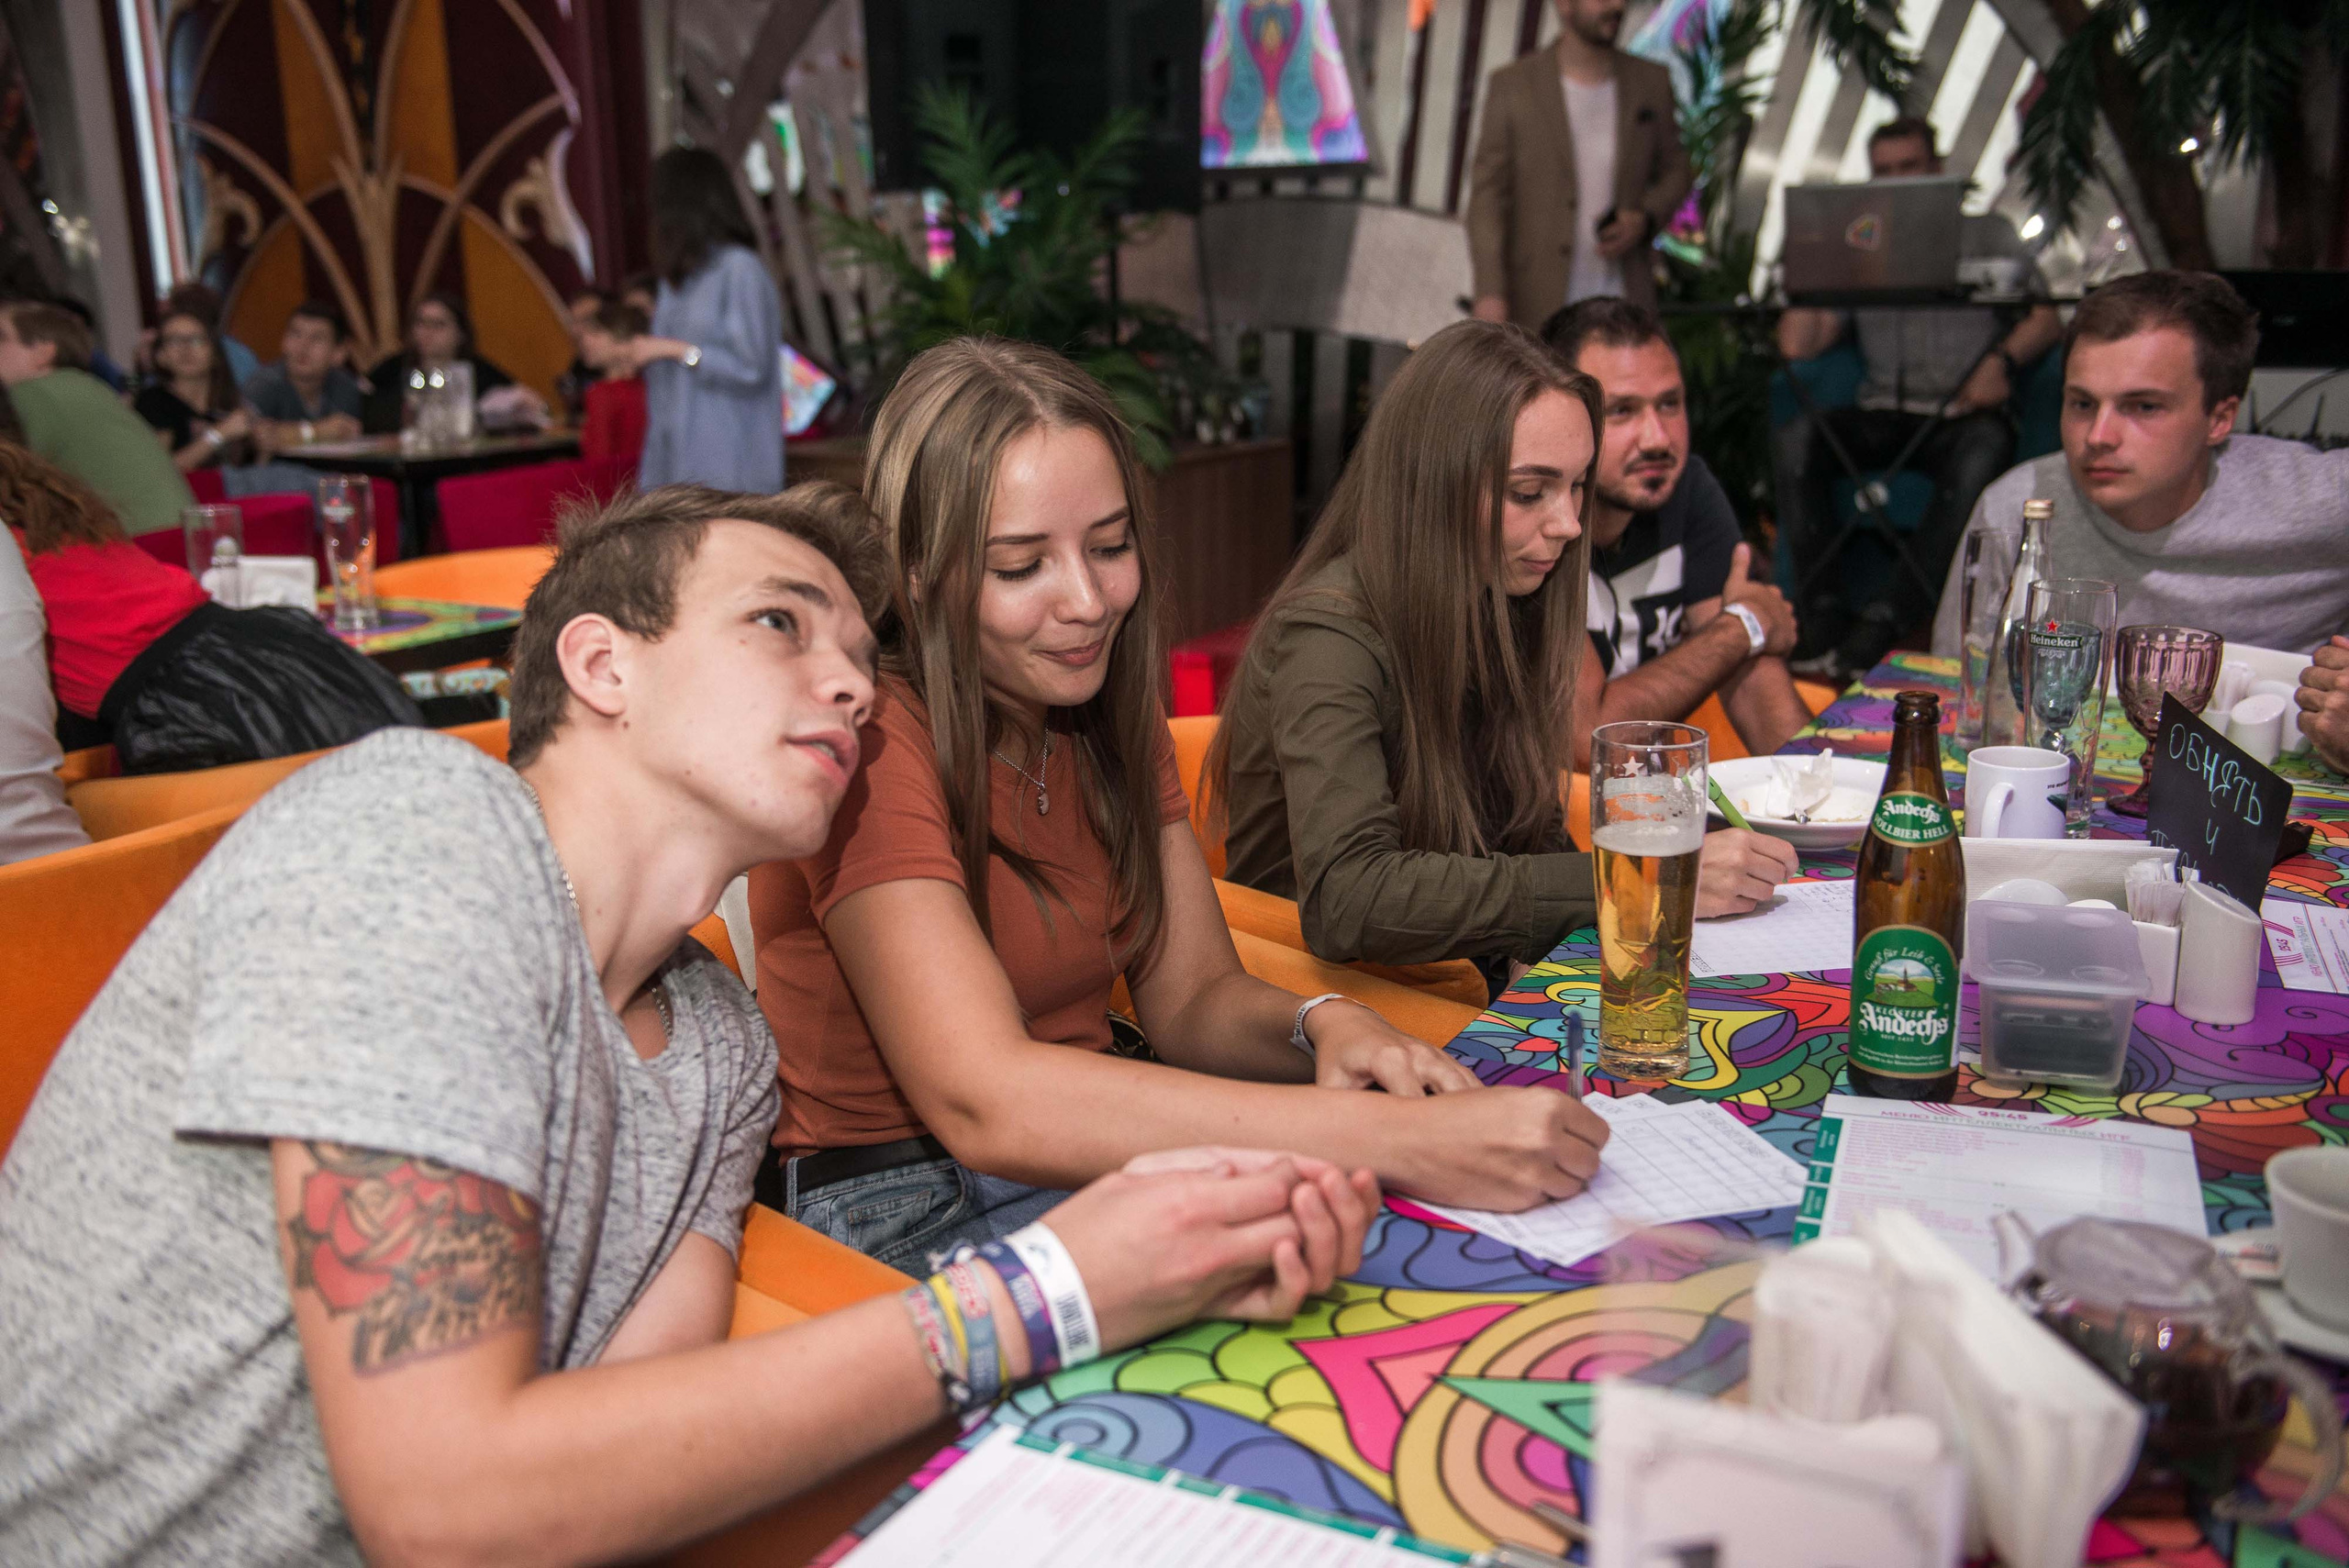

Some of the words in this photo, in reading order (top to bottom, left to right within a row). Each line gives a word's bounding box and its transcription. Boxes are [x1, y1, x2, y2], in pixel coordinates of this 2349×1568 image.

[2030, 633, 2079, 648] Heineken
[2168, 723, 2264, 826] ОБНЯТЬ
[1882, 799, 1941, 824] Andechs
[1874, 813, 1921, 840] VOLLBIER
[1922, 825, 1949, 839] HELL
[1901, 947, 1925, 960] Leib
[1875, 1006, 1925, 1018] KLOSTER
[1858, 1001, 1949, 1046] Andechs
[1880, 1110, 1930, 1119] МЕНЮ
